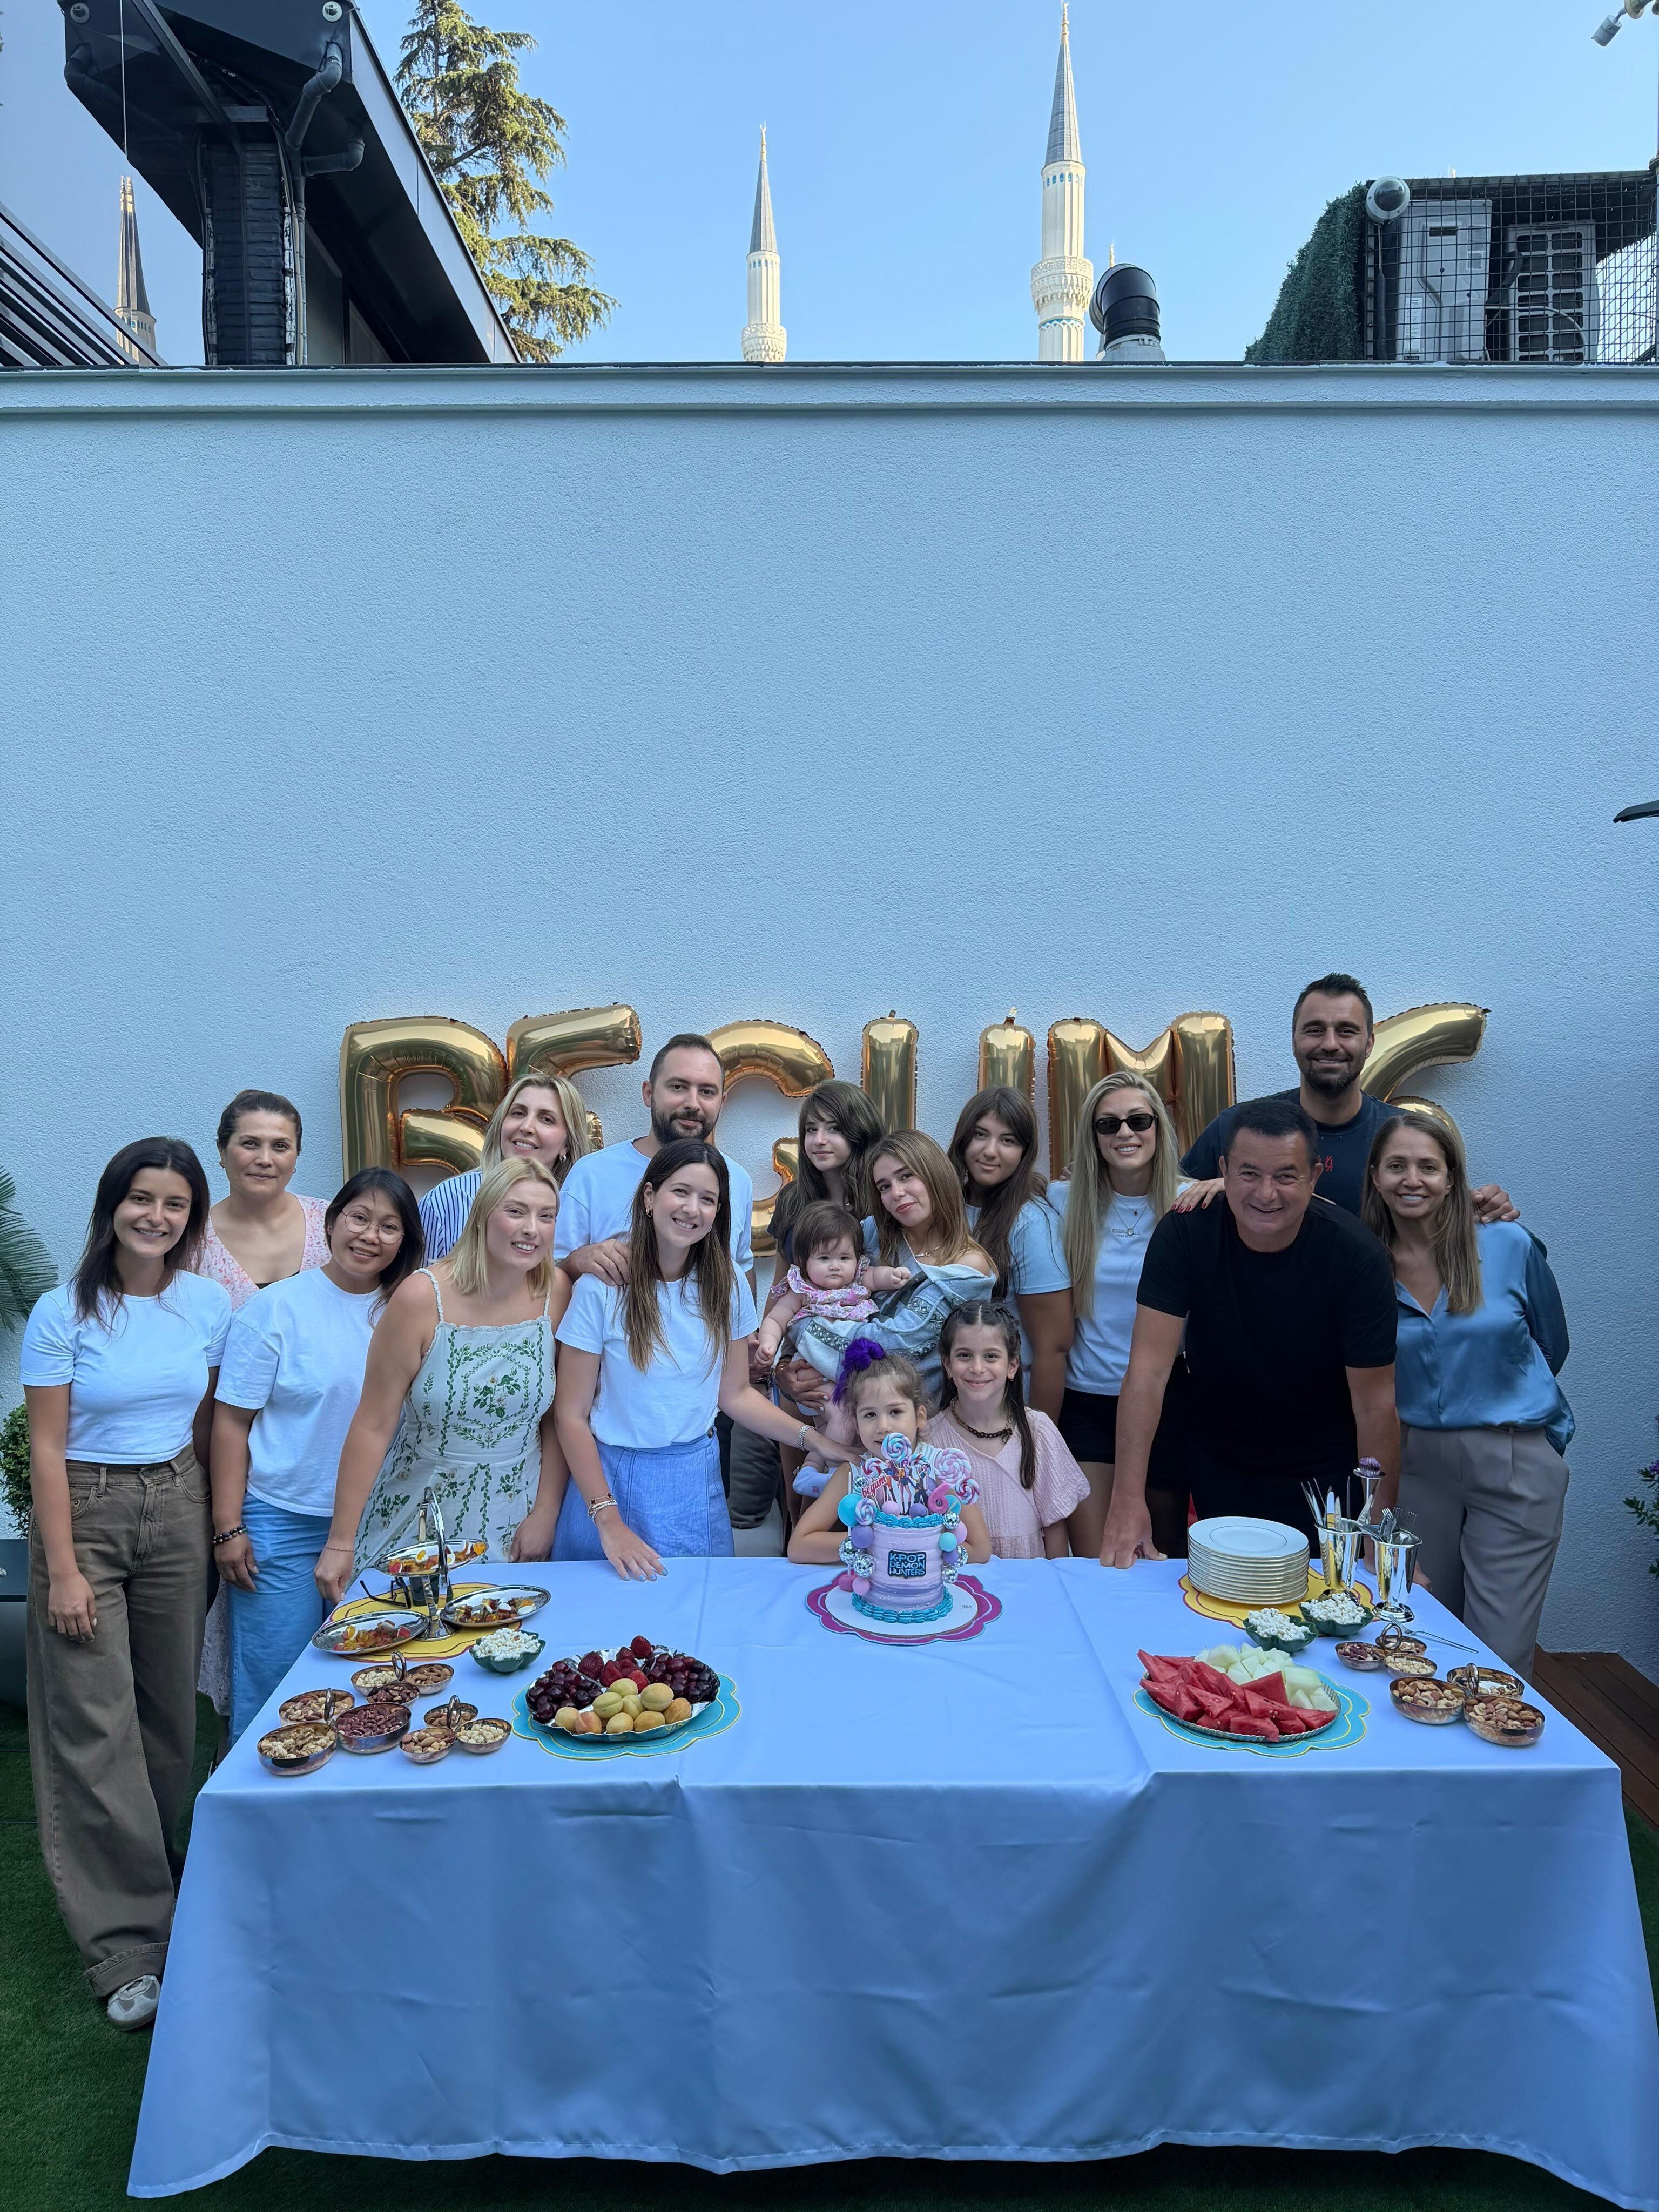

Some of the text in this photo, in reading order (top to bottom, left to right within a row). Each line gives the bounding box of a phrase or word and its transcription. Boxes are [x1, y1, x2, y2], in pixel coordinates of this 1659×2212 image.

[927, 1482, 950, 1514] 6
[889, 1553, 925, 1562] K-POP
[889, 1559, 925, 1569] DEMON
[889, 1567, 925, 1577] HUNTERS
